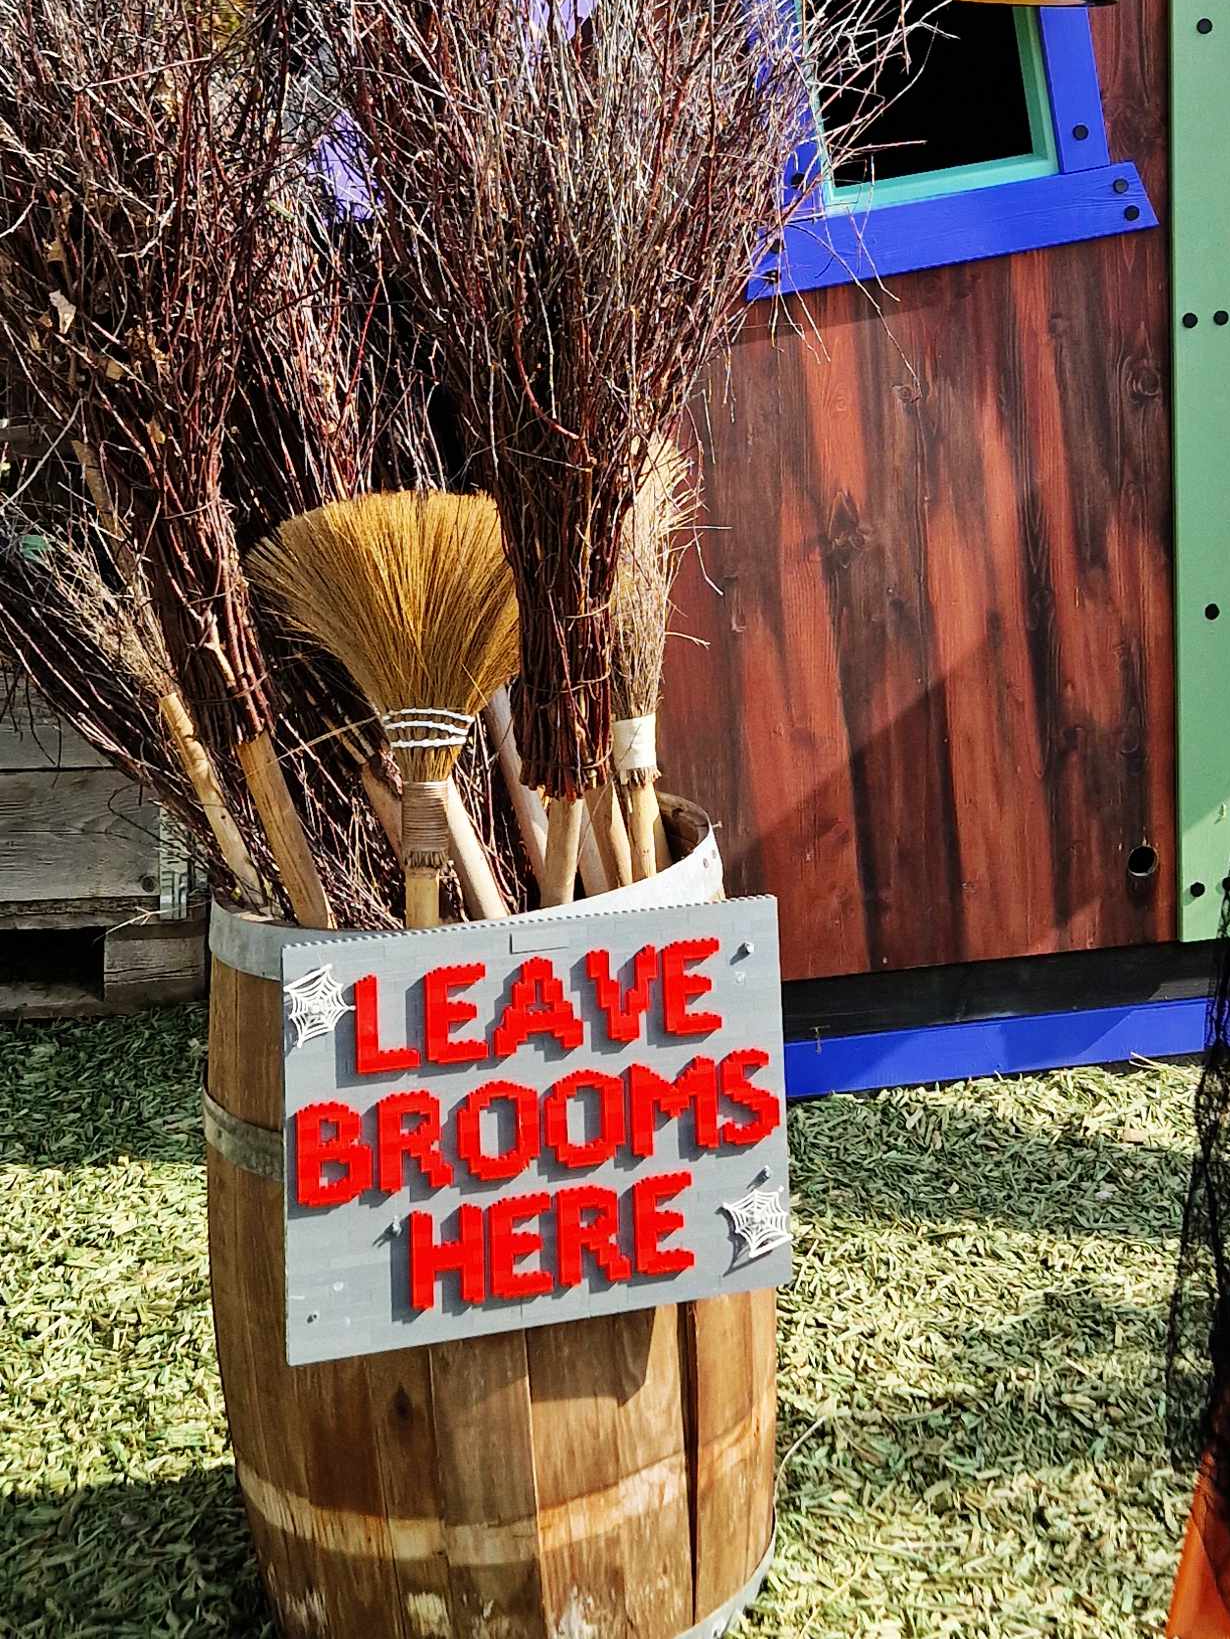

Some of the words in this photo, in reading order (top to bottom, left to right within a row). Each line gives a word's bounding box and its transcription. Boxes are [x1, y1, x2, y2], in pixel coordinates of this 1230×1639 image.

[354, 938, 721, 1073] LEAVE
[296, 1049, 780, 1206] BROOMS
[410, 1173, 695, 1310] HERE
